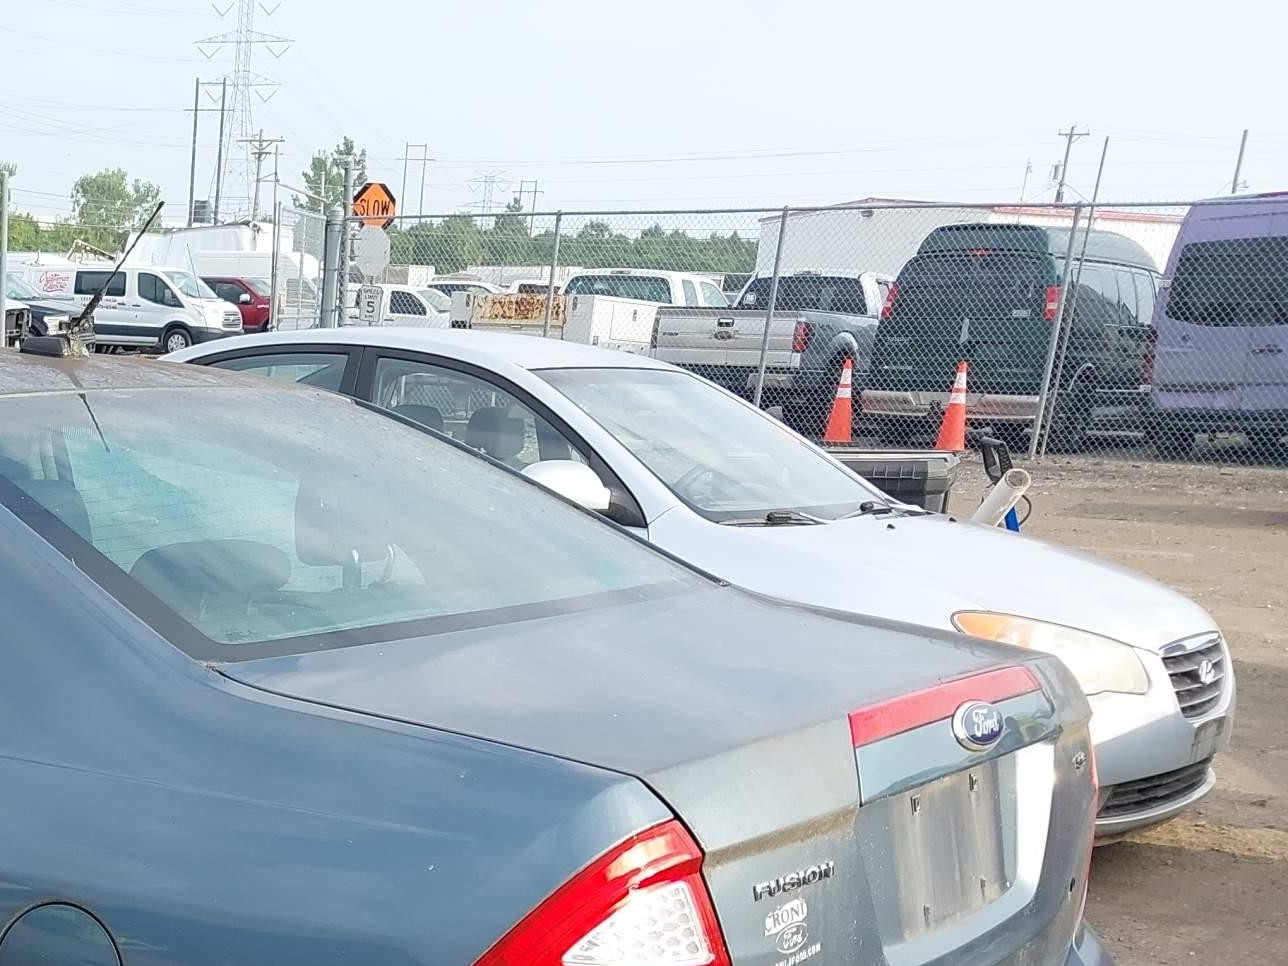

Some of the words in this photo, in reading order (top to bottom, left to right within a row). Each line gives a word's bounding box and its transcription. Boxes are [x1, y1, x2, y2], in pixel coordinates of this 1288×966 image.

[360, 199, 390, 216] SLOW
[366, 300, 375, 314] 5
[972, 708, 1000, 738] Ford
[752, 860, 835, 901] FUSION
